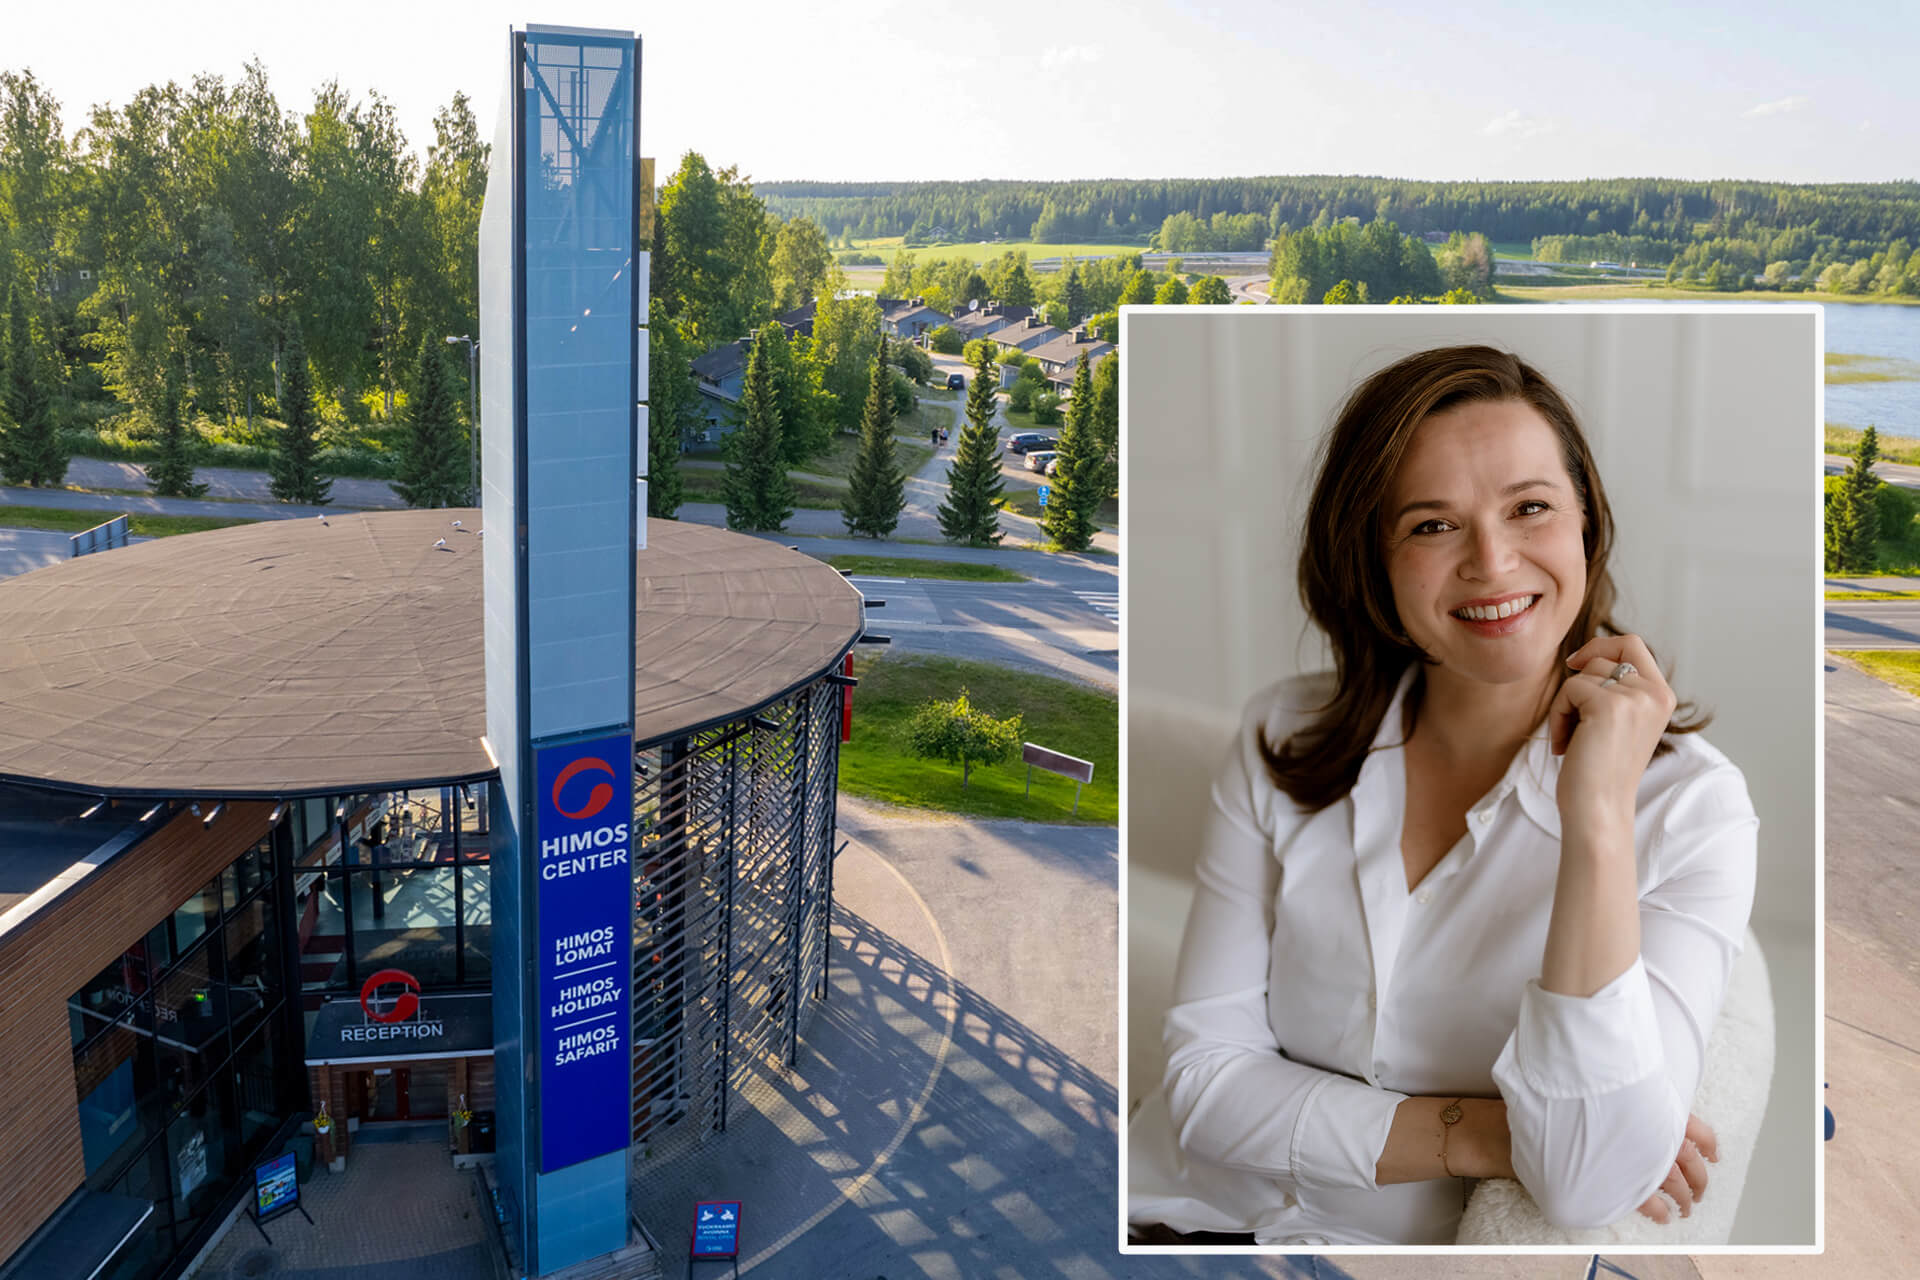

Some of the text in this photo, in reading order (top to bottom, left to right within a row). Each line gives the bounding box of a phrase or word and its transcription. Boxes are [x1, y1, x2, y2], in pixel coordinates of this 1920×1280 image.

[542, 823, 628, 859] HIMOS
[542, 849, 628, 880] CENTER
[556, 926, 614, 952] HIMOS
[556, 940, 614, 966] LOMAT
[560, 977, 614, 1001] HIMOS
[551, 988, 622, 1018] HOLIDAY
[340, 1023, 444, 1042] RECEPTION
[559, 1025, 616, 1051] HIMOS
[555, 1038, 620, 1066] SAFARIT
